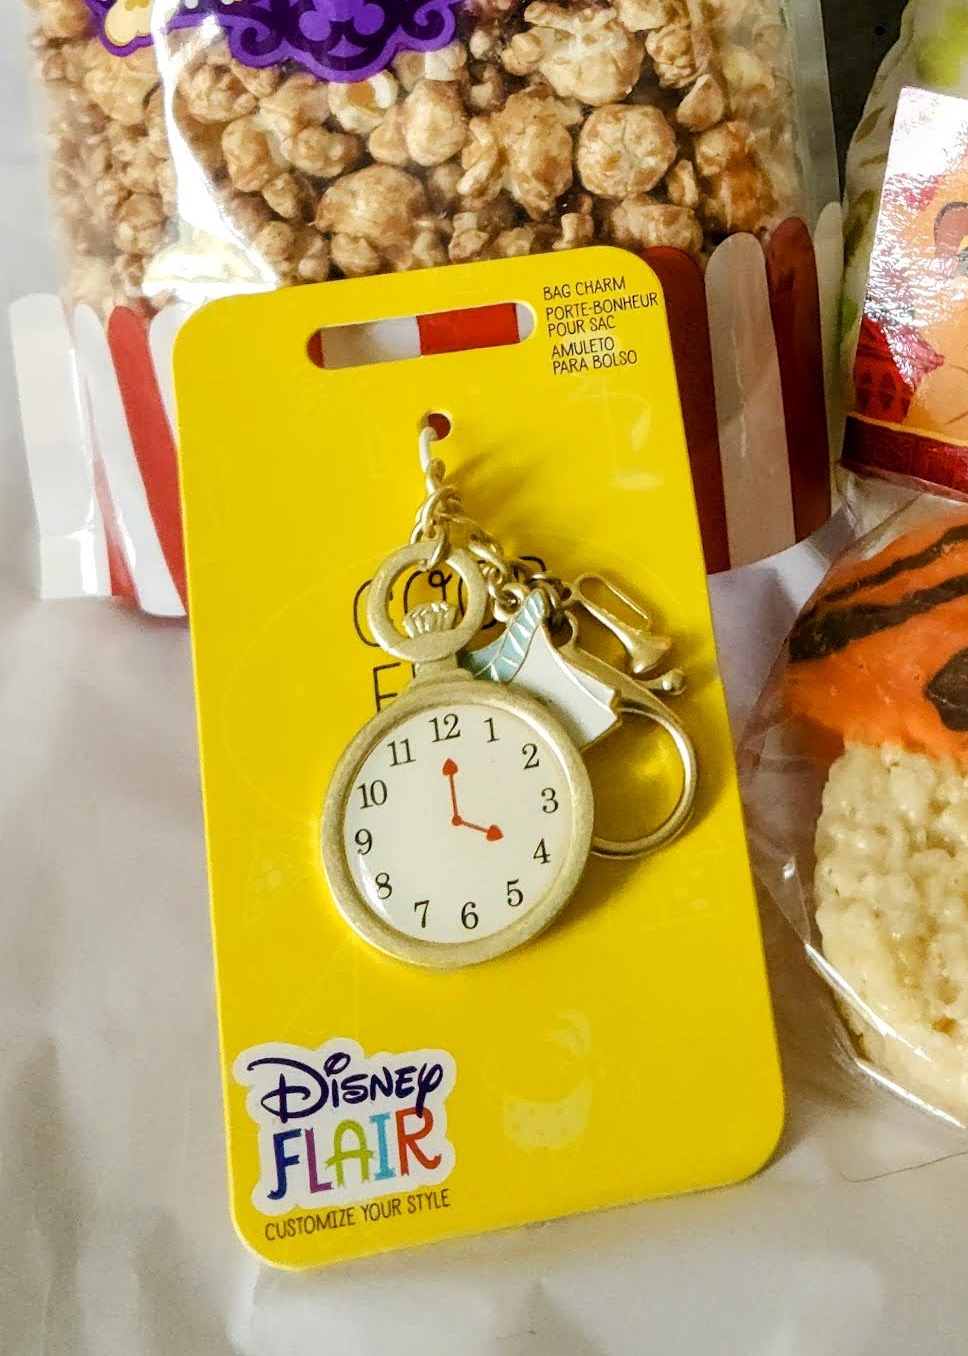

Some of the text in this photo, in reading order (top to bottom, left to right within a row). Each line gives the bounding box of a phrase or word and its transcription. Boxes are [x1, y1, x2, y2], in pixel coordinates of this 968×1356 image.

[543, 275, 626, 301] BAG CHARM
[545, 291, 659, 322] PORTE-BONHEUR
[548, 314, 616, 338] POUR SAC
[551, 336, 615, 359] AMULETO
[552, 349, 638, 375] PARA BOLSO
[428, 713, 461, 743] 12
[484, 717, 500, 743] 1
[387, 738, 416, 767] 11
[521, 743, 540, 770] 2
[356, 779, 388, 809] 10
[541, 787, 559, 814] 3
[354, 828, 373, 856] 9
[533, 837, 551, 865] 4
[374, 872, 393, 900] 8
[506, 878, 524, 907] 5
[413, 900, 430, 928] 7
[460, 901, 479, 930] 6
[246, 1051, 444, 1124] Disney
[266, 1106, 443, 1201] FLAIR
[264, 1188, 451, 1241] CUSTOMIZE YOUR STYLE
